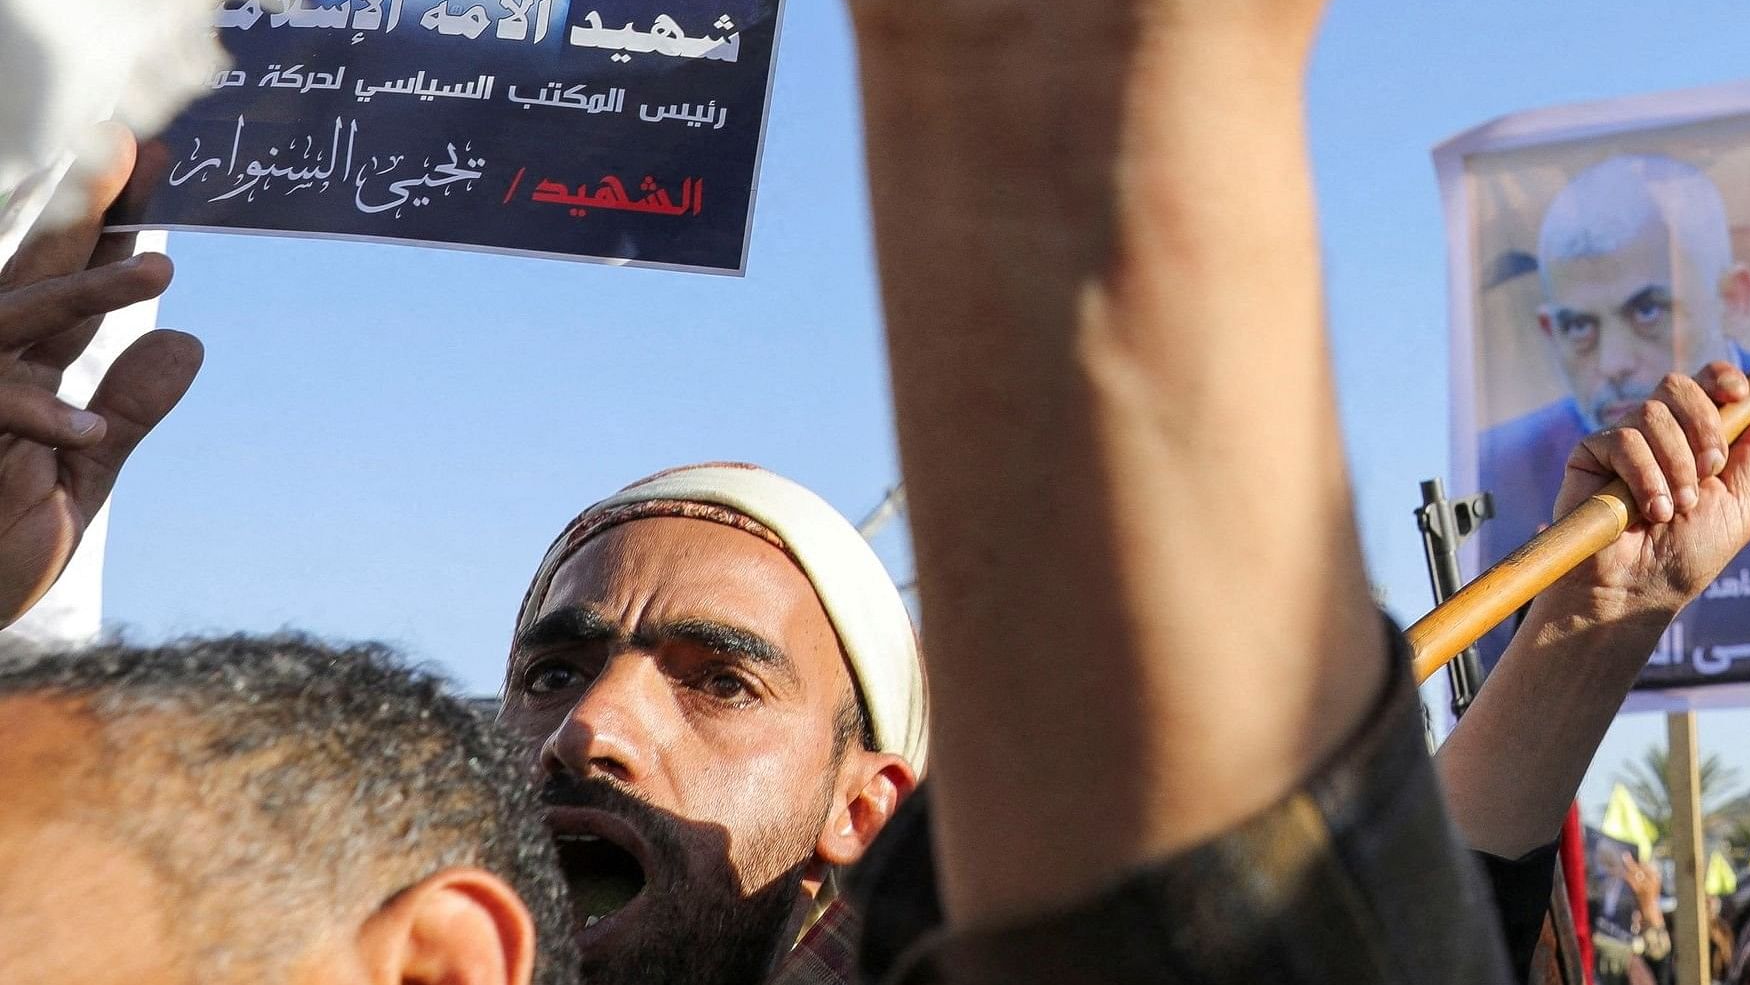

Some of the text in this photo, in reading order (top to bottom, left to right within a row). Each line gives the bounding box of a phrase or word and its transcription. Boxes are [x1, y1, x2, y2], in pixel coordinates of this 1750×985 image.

[570, 12, 741, 64] شهيد
[258, 64, 346, 94] لحركة
[354, 71, 496, 103] السياسي
[508, 84, 626, 114] المكتب
[640, 99, 728, 130] رئيس
[168, 116, 358, 206] السنوار
